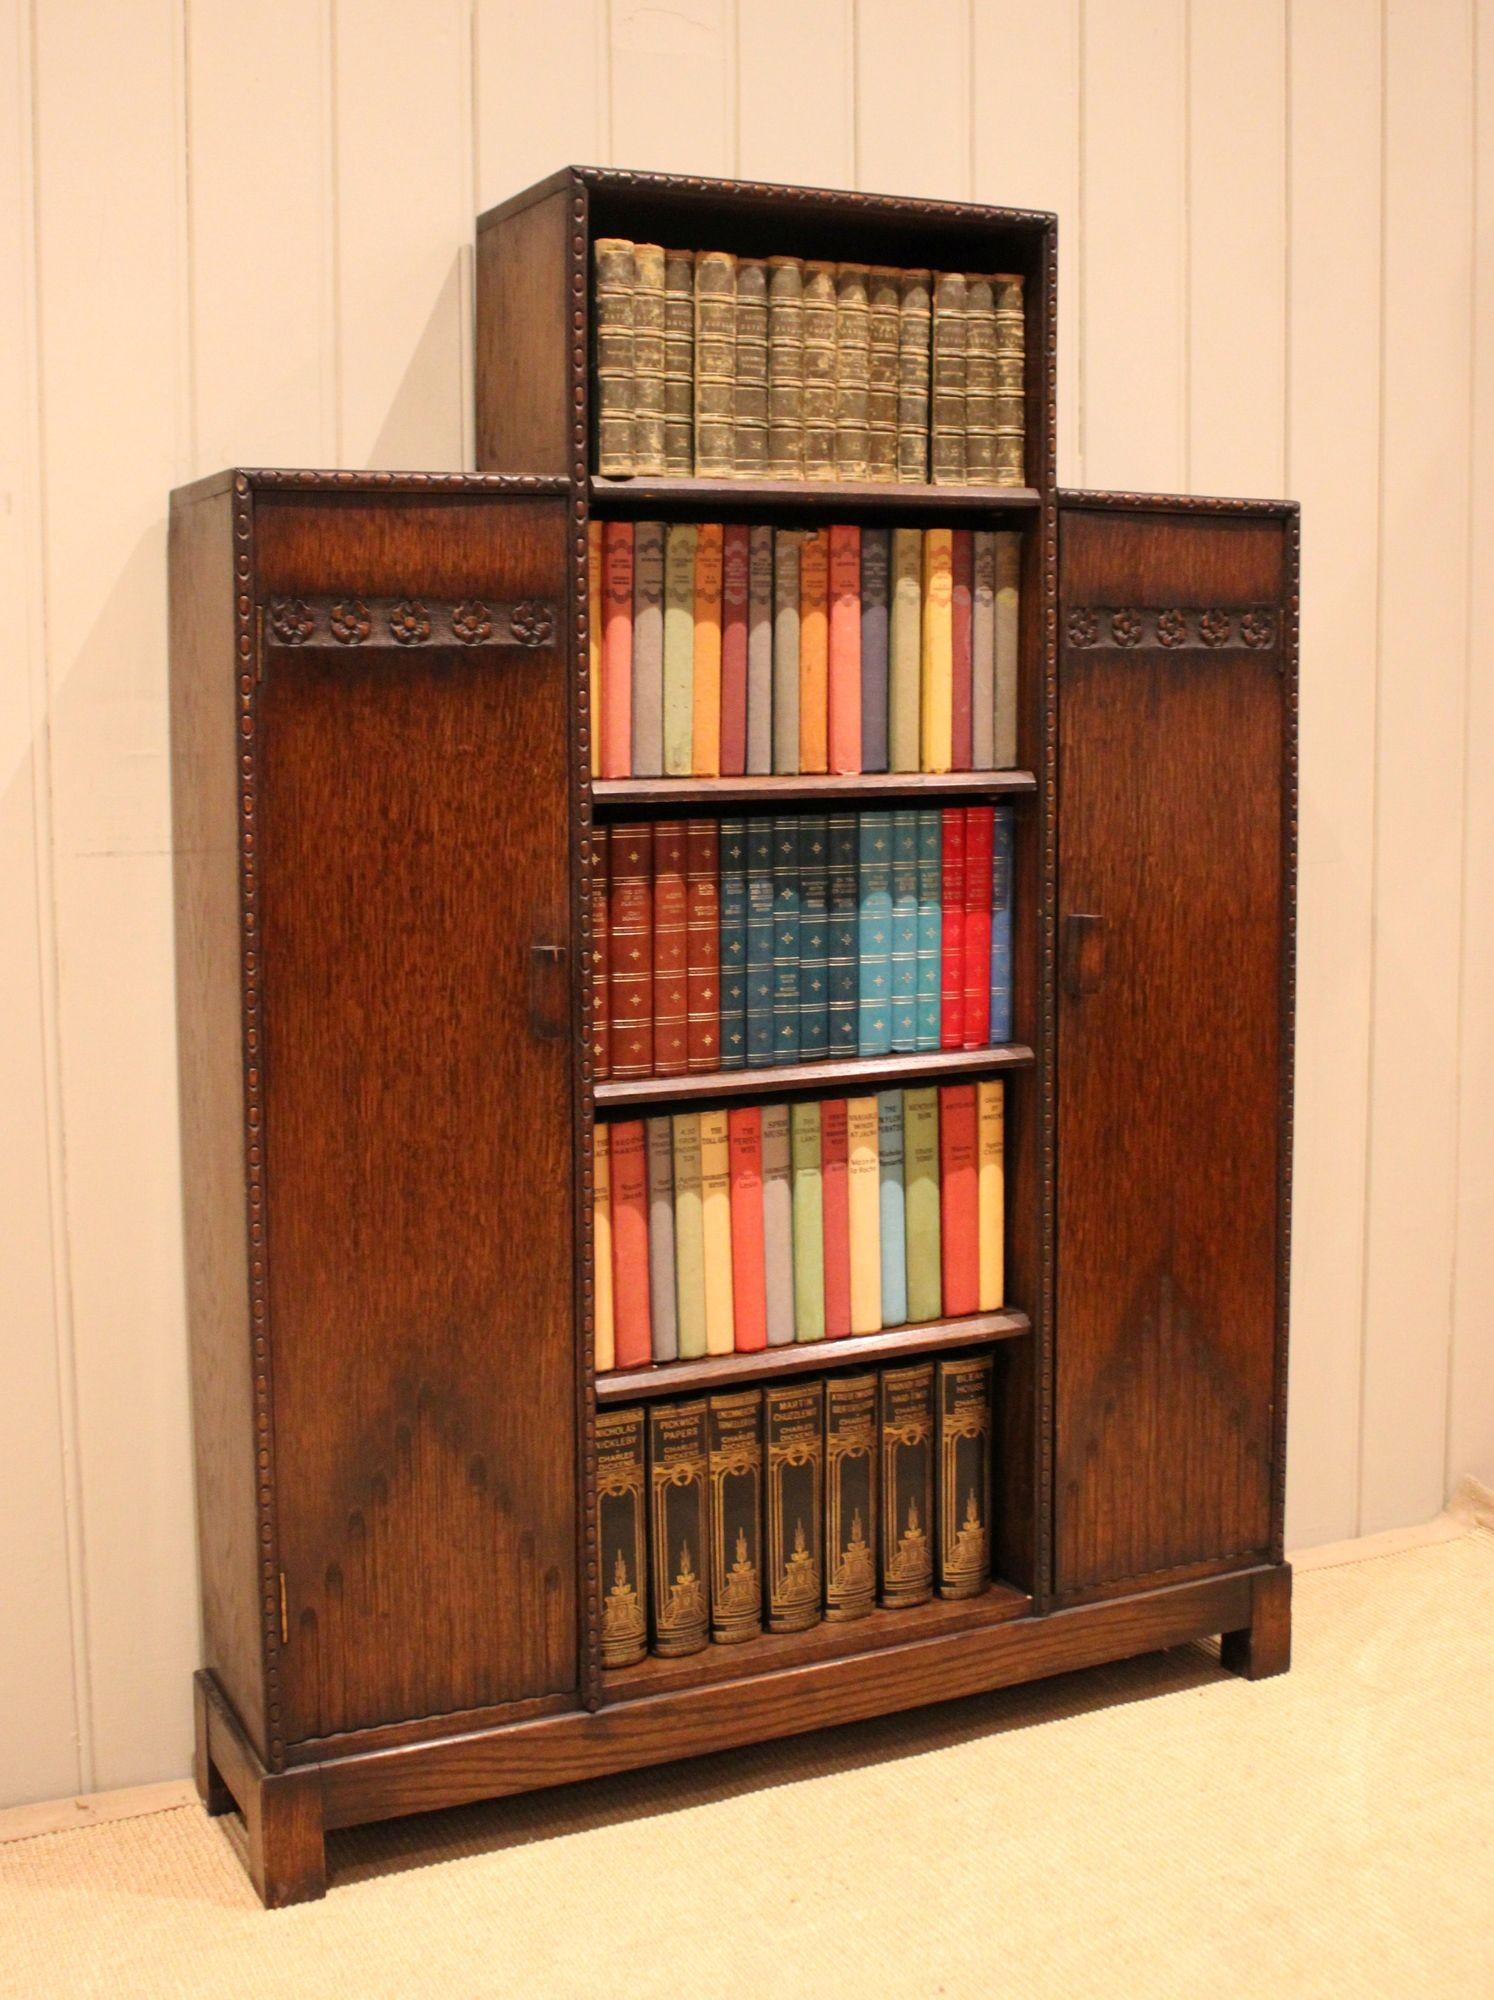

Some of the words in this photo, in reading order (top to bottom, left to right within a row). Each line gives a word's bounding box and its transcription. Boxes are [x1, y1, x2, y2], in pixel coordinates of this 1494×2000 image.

[956, 1372, 985, 1384] BLEAK
[956, 1382, 985, 1394] HOUSE
[779, 1397, 814, 1411] MARTIN
[954, 1396, 986, 1408] CHARLES
[894, 1403, 927, 1415] CHARLES
[838, 1414, 871, 1426] CHARLES
[894, 1410, 927, 1422] DICKENS
[660, 1415, 700, 1430] PICKWICK
[838, 1422, 871, 1434] DICKENS
[663, 1426, 699, 1441] PAPERS
[780, 1423, 815, 1435] CHARLES
[720, 1431, 756, 1443] CHARLES
[780, 1431, 815, 1442] DICKENS
[663, 1442, 699, 1454] CHARLES
[720, 1439, 757, 1451] DICKENS
[598, 1451, 635, 1463] CHARLES
[664, 1450, 699, 1462] DICKENS
[598, 1459, 635, 1471] DICKENS
